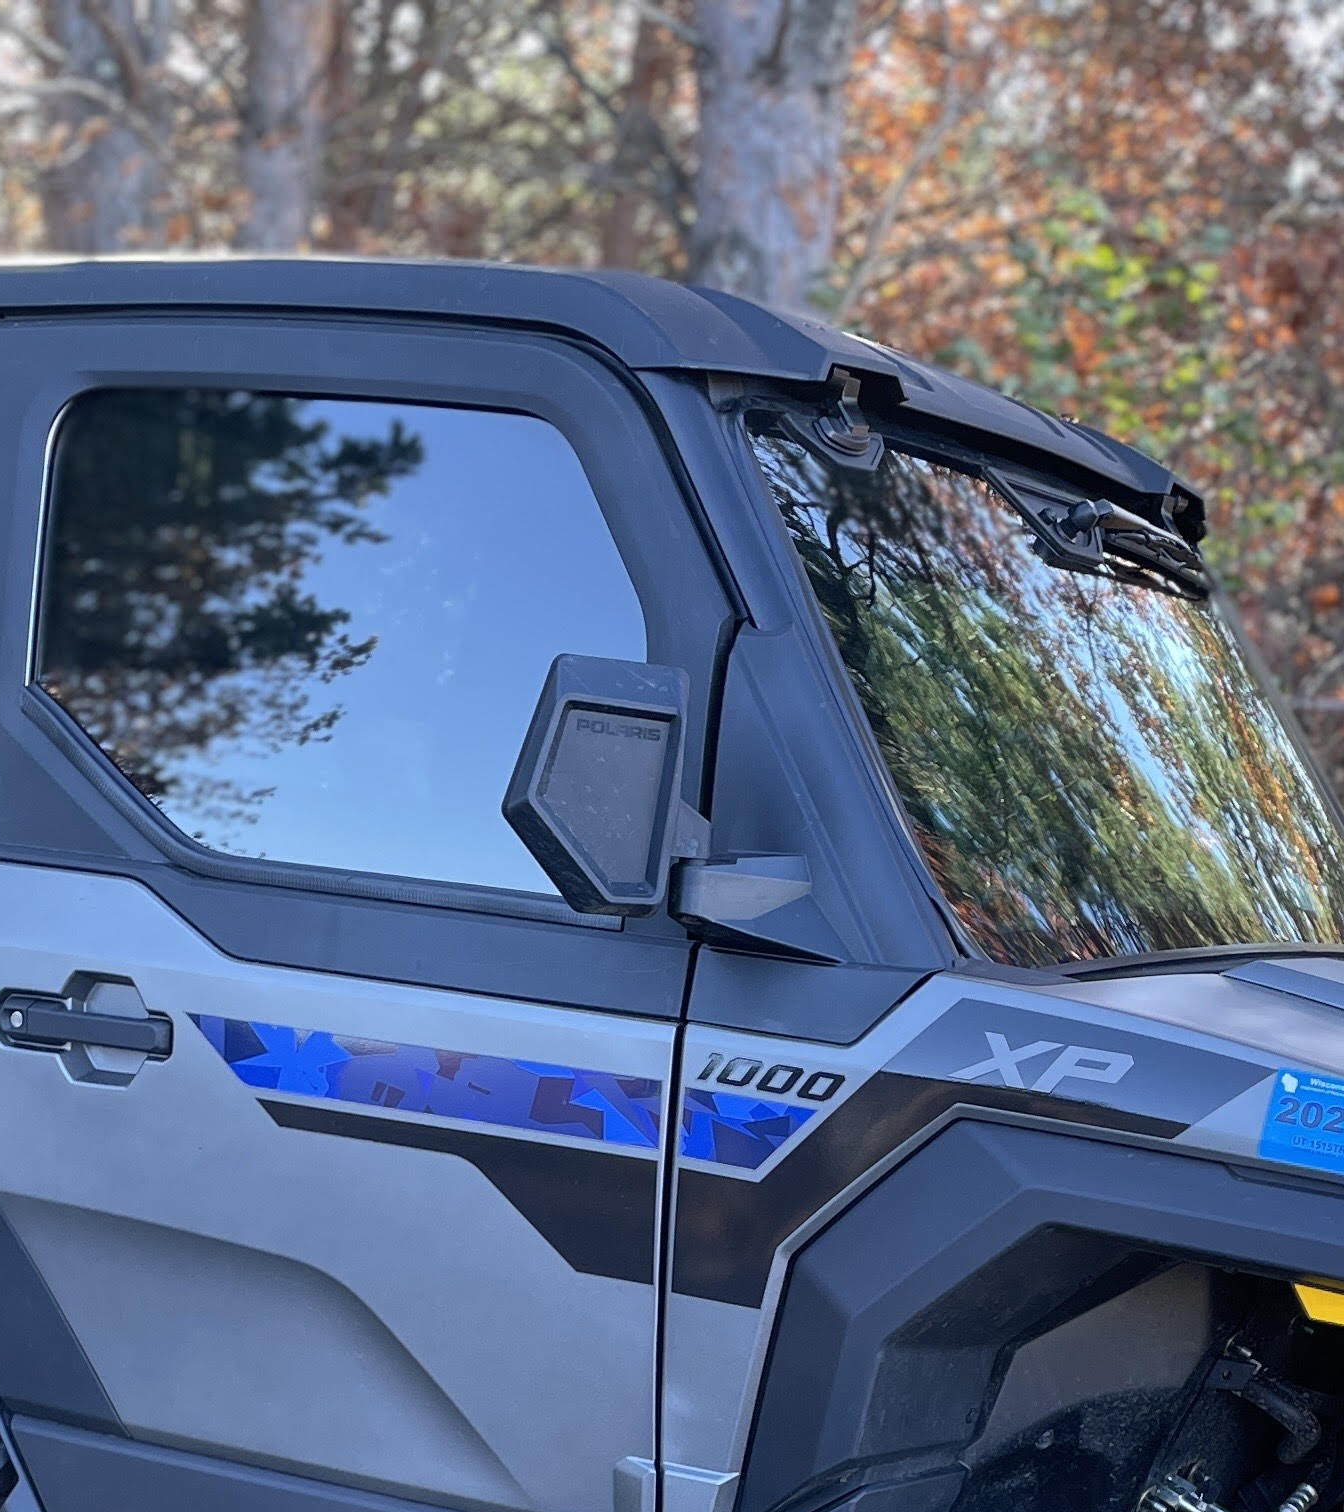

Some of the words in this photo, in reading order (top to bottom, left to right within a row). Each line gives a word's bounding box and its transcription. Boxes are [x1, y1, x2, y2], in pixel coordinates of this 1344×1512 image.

[576, 718, 661, 742] POLARIS
[696, 1052, 846, 1100] 1000
[948, 1032, 1135, 1094] XP
